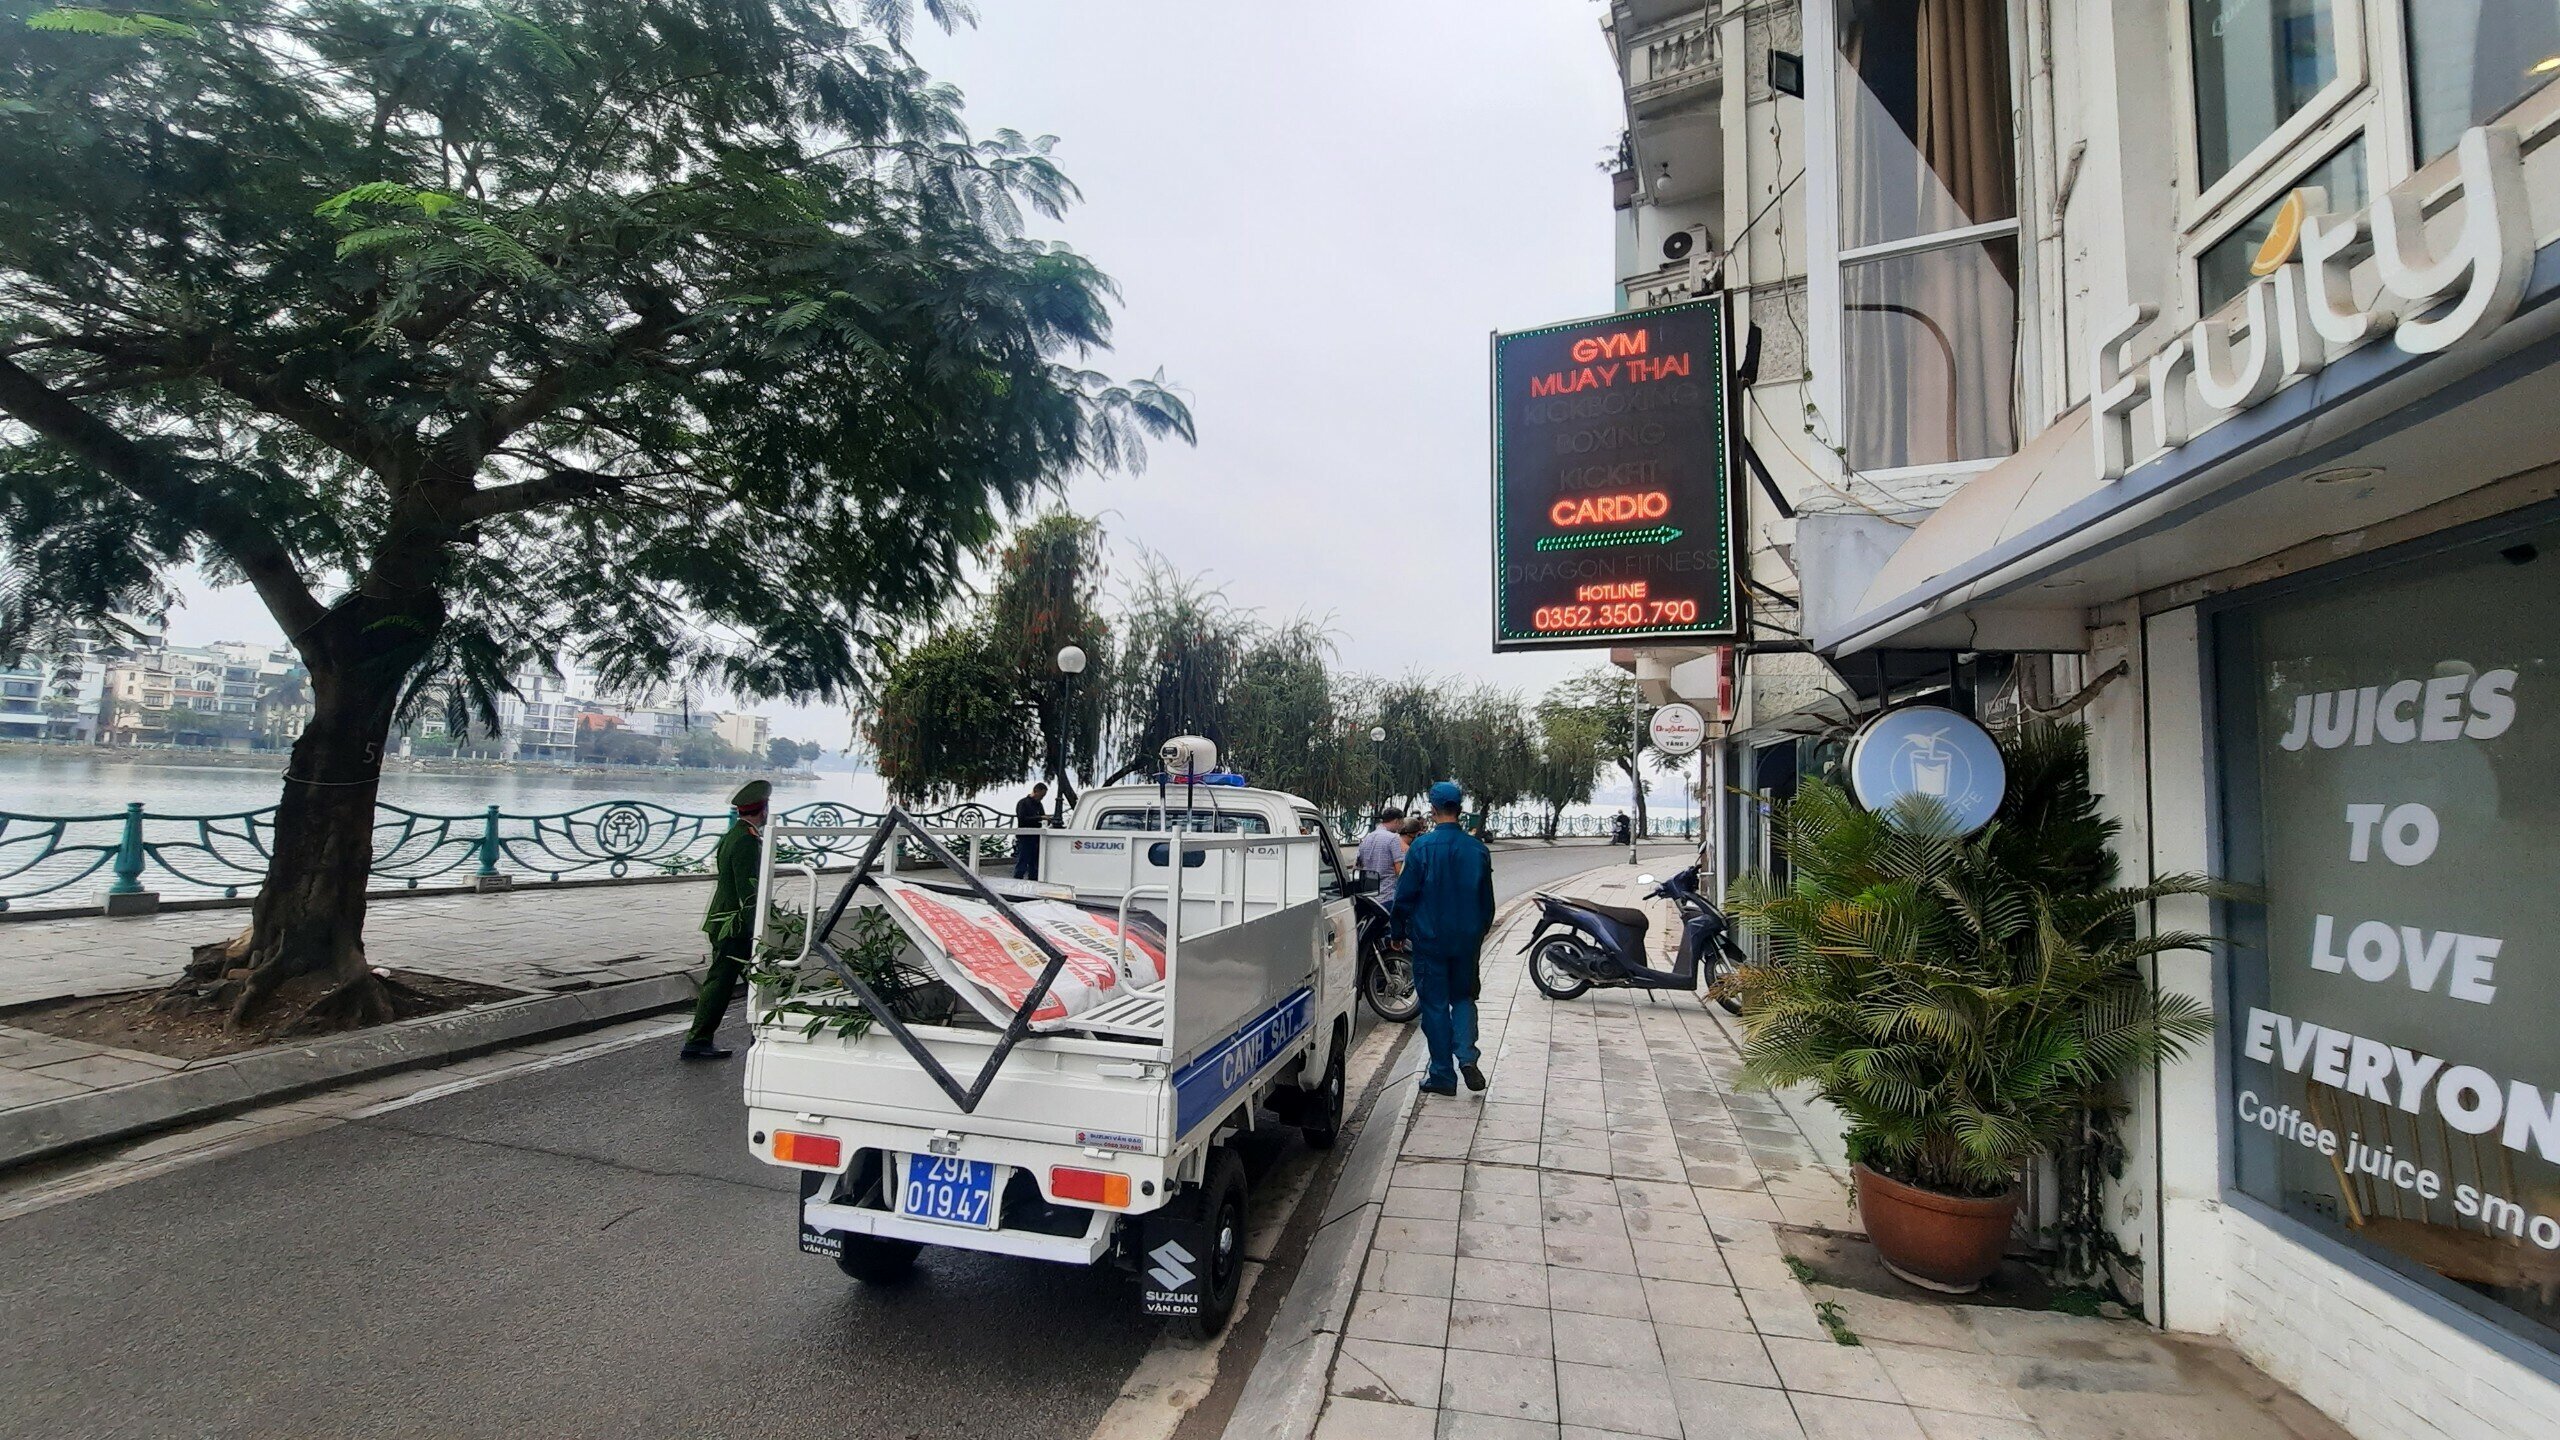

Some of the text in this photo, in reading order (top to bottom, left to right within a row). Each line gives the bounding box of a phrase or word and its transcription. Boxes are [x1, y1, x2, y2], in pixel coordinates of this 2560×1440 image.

[1572, 329, 1647, 362] GYM
[1531, 352, 1691, 398] MUAY THAI
[1555, 422, 1666, 454] BOXING
[1551, 491, 1670, 526] CARDIO
[1506, 548, 1720, 584] DRAGON FITNESS
[1578, 582, 1646, 602] HOTLINE
[1535, 600, 1695, 630] 0352.350.790
[2280, 669, 2518, 752] JUICES
[1084, 841, 1124, 851] SUZUKI
[2345, 802, 2440, 866] TO
[2311, 914, 2503, 1004] LOVE
[928, 1157, 972, 1185] 29A
[2238, 1089, 2560, 1250] Coffee juice smo
[907, 1180, 990, 1222] 019.47
[802, 1233, 842, 1249] SUZUKI
[1146, 1290, 1199, 1304] SUZUKI
[1147, 1302, 1171, 1312] VÂN
